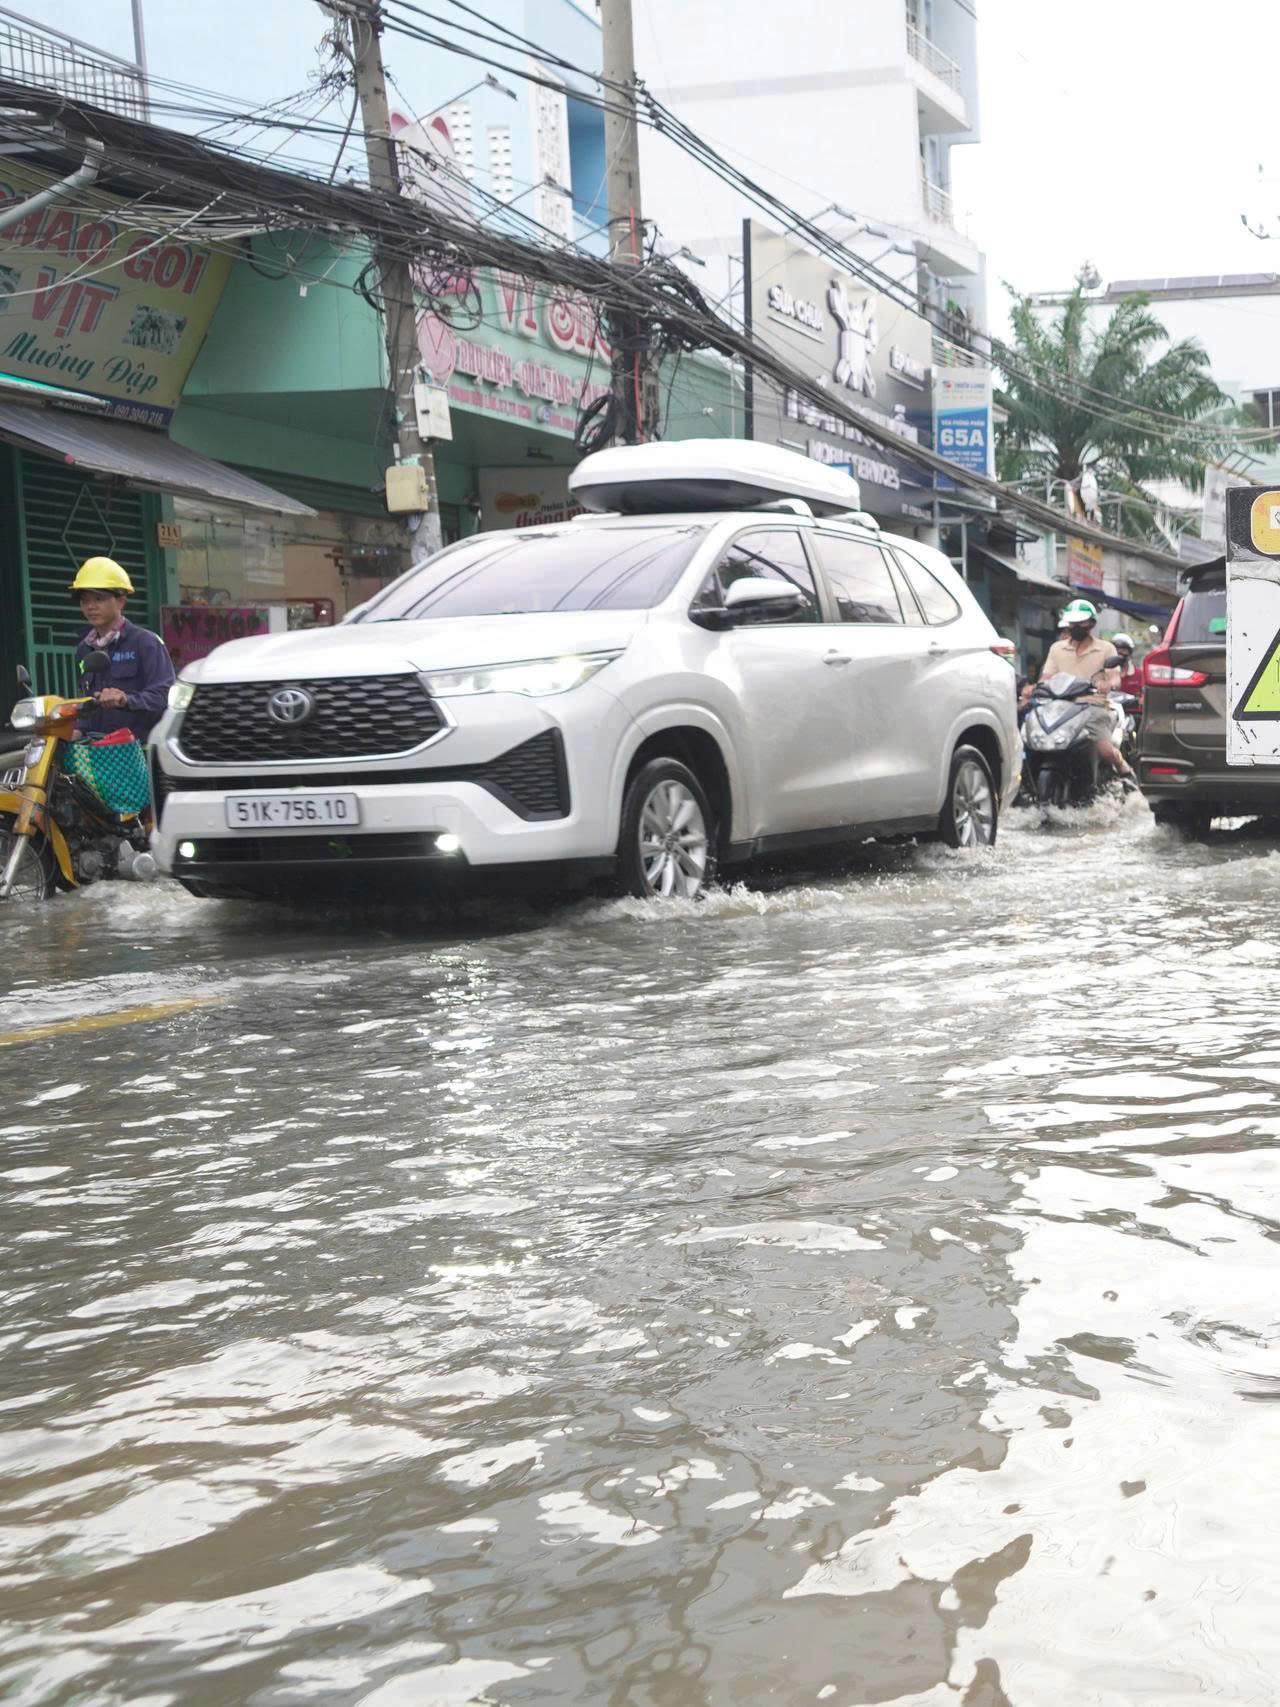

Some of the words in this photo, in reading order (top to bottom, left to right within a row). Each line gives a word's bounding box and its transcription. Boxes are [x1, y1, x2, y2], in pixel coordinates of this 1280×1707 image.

[32, 267, 118, 338] VỊT
[5, 332, 94, 381] Muống
[103, 355, 158, 394] Đập
[940, 428, 984, 446] 65A
[235, 799, 348, 822] 51K-756.10
